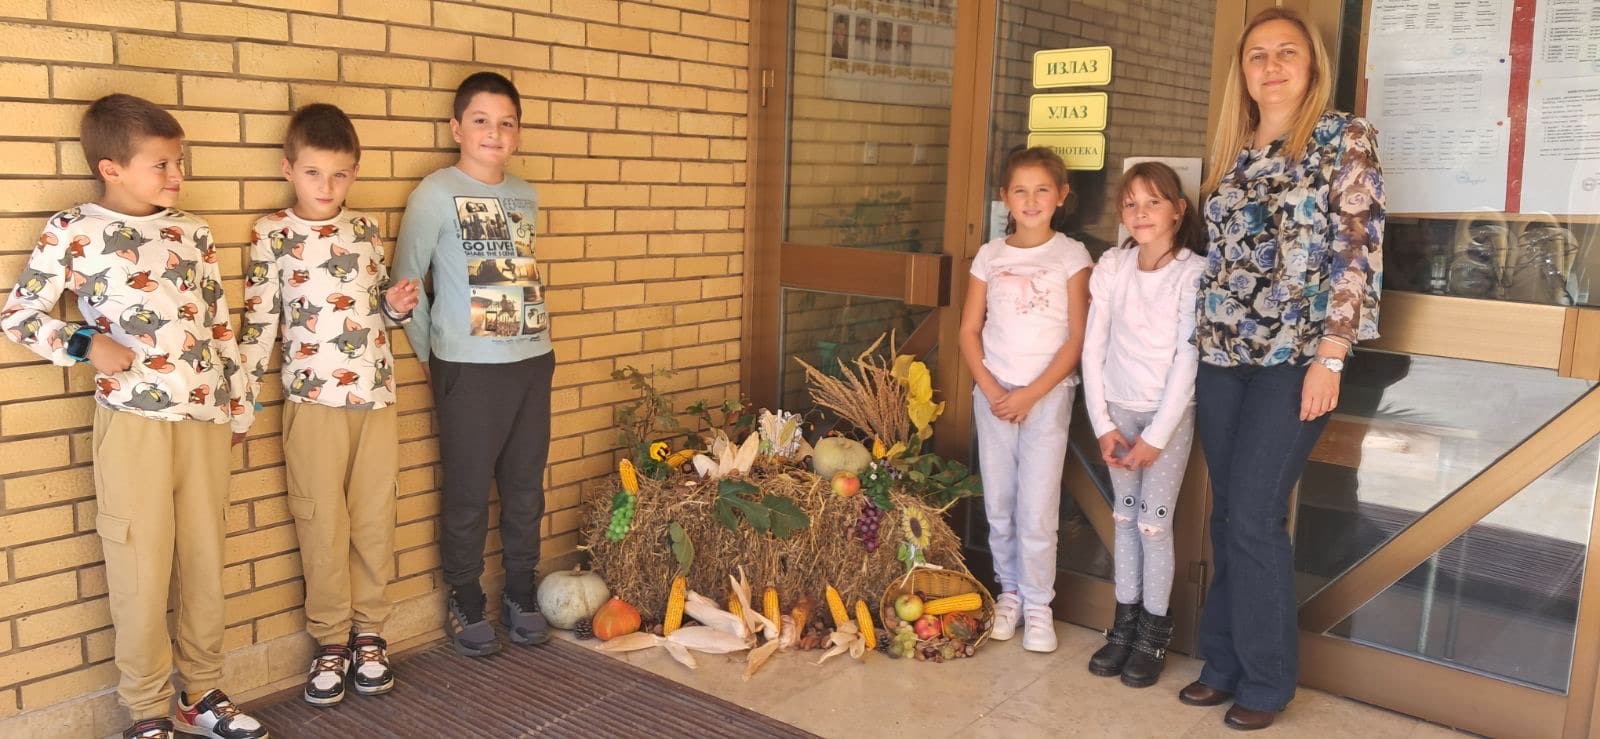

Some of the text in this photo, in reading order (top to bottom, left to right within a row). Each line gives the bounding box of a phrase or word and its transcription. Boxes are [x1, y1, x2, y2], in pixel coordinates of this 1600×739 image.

[1047, 59, 1097, 75] ИЗЛАЗ
[1047, 105, 1088, 119] УЛАЗ
[1055, 146, 1098, 155] ИОТЕКА
[462, 241, 515, 251] GO LIVE!
